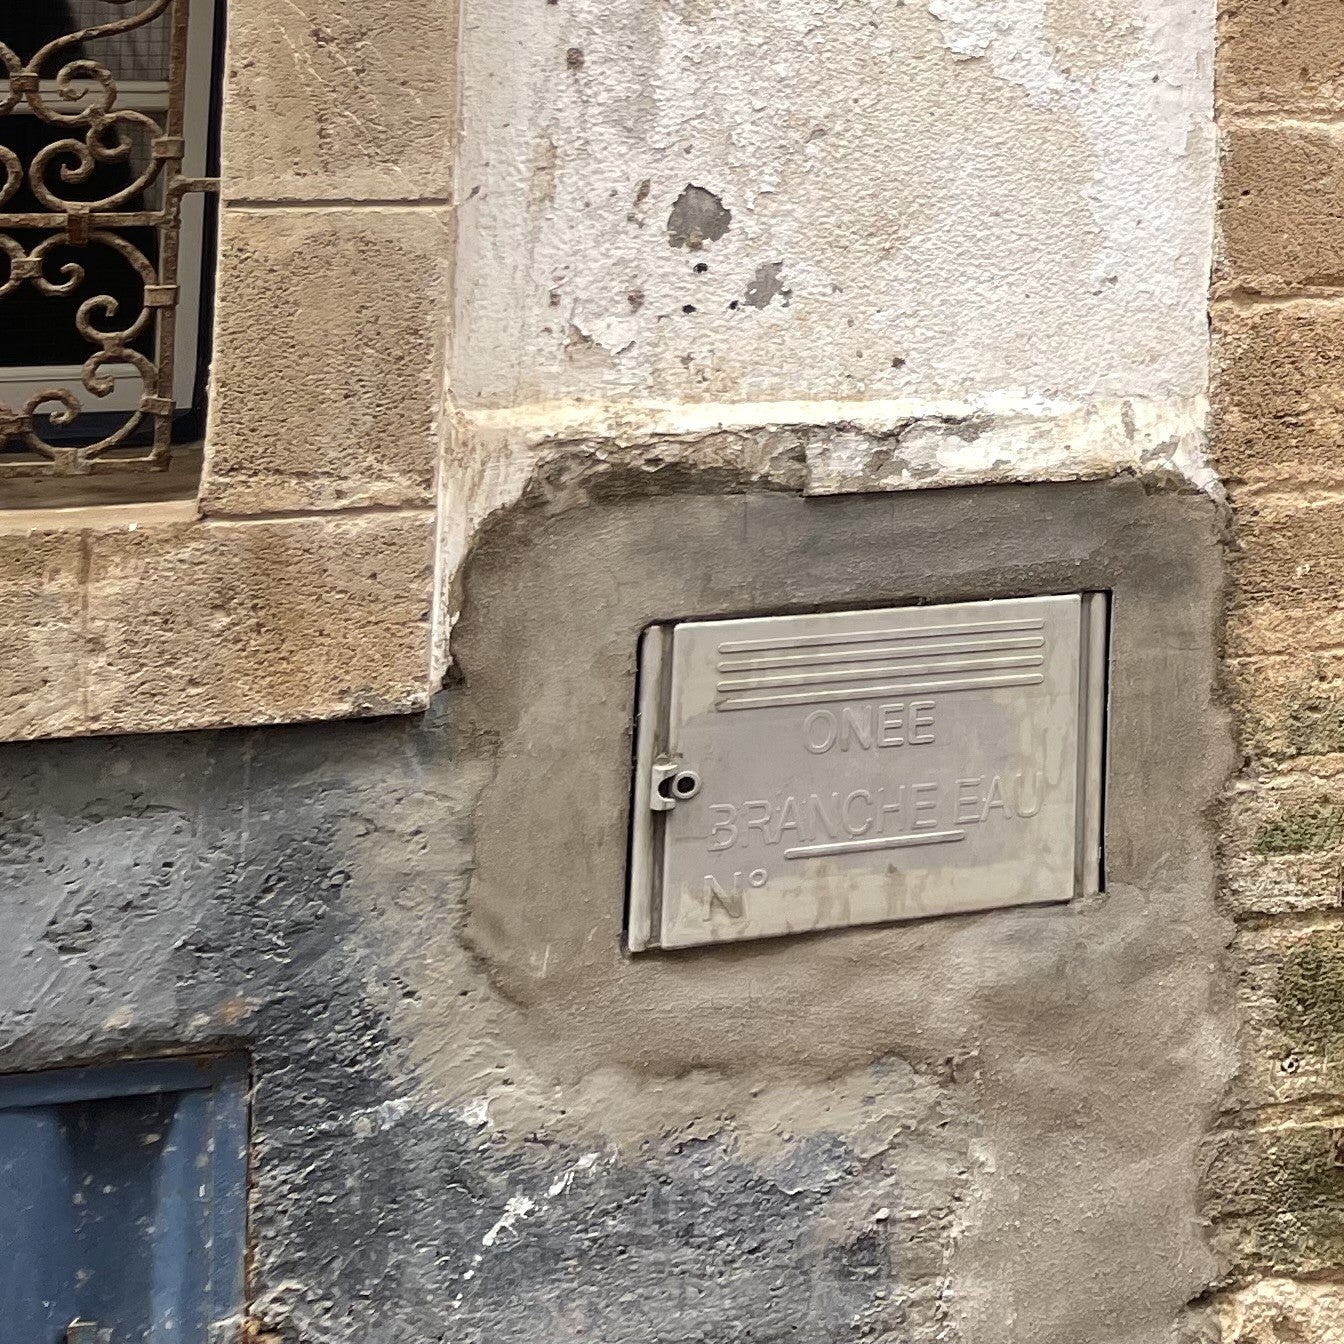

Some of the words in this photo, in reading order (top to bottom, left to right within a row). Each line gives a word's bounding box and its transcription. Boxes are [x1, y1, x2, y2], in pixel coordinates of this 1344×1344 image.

[803, 700, 936, 755] ONEE
[707, 782, 937, 852] BRANCHE
[955, 771, 1045, 826] EAU
[702, 868, 769, 923] N°
